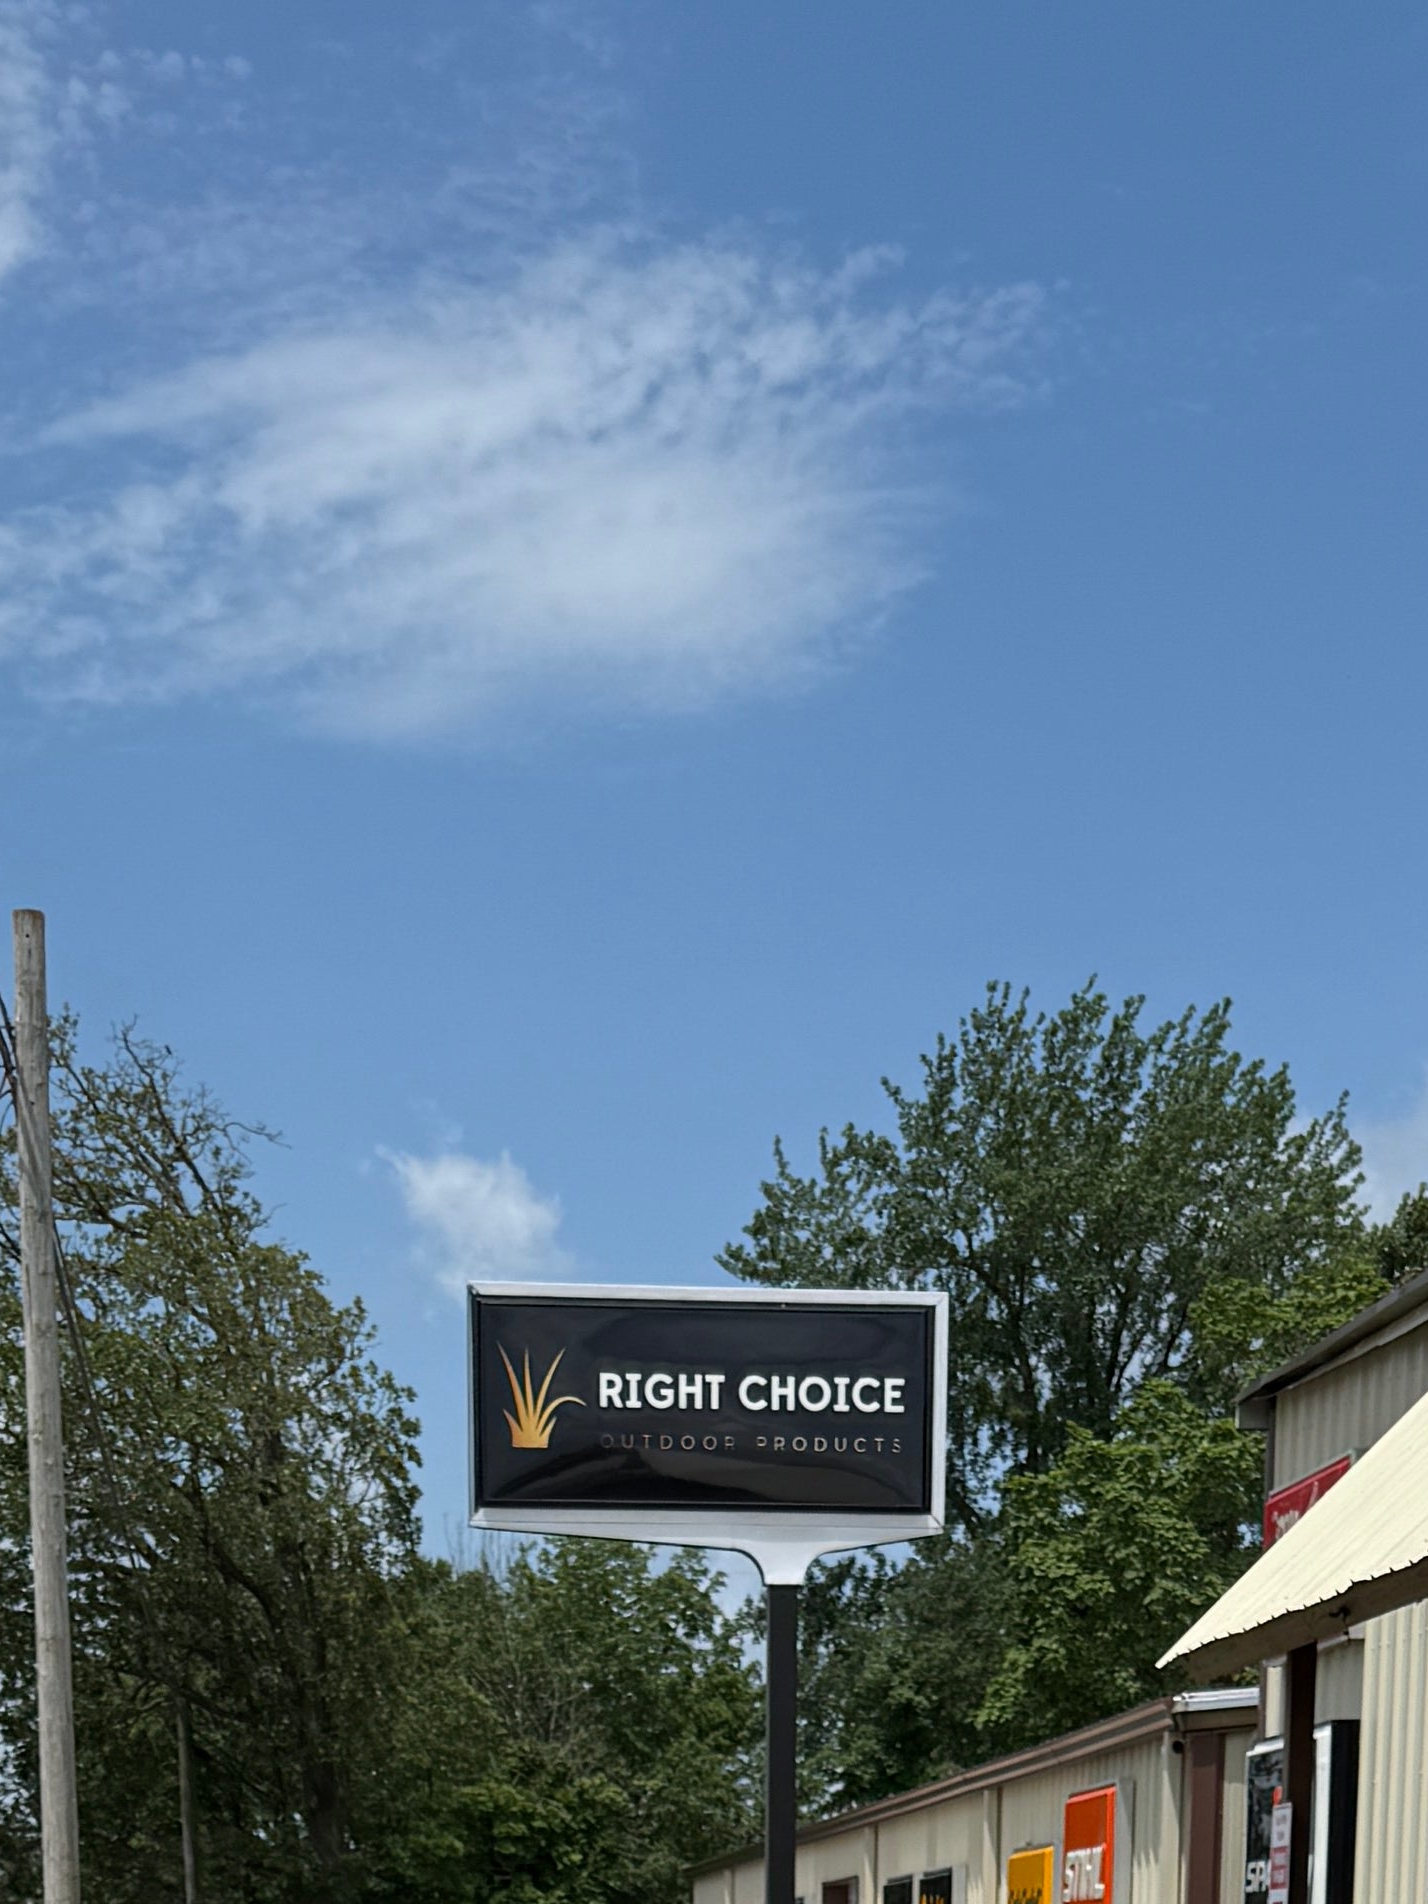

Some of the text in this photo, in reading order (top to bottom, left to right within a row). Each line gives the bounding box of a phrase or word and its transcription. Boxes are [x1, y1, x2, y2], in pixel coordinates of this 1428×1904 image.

[599, 1371, 906, 1414] RIGHT CHOICE
[600, 1433, 903, 1454] OUTDOOR PRODUCTS
[1063, 1843, 1107, 1903] STIHL
